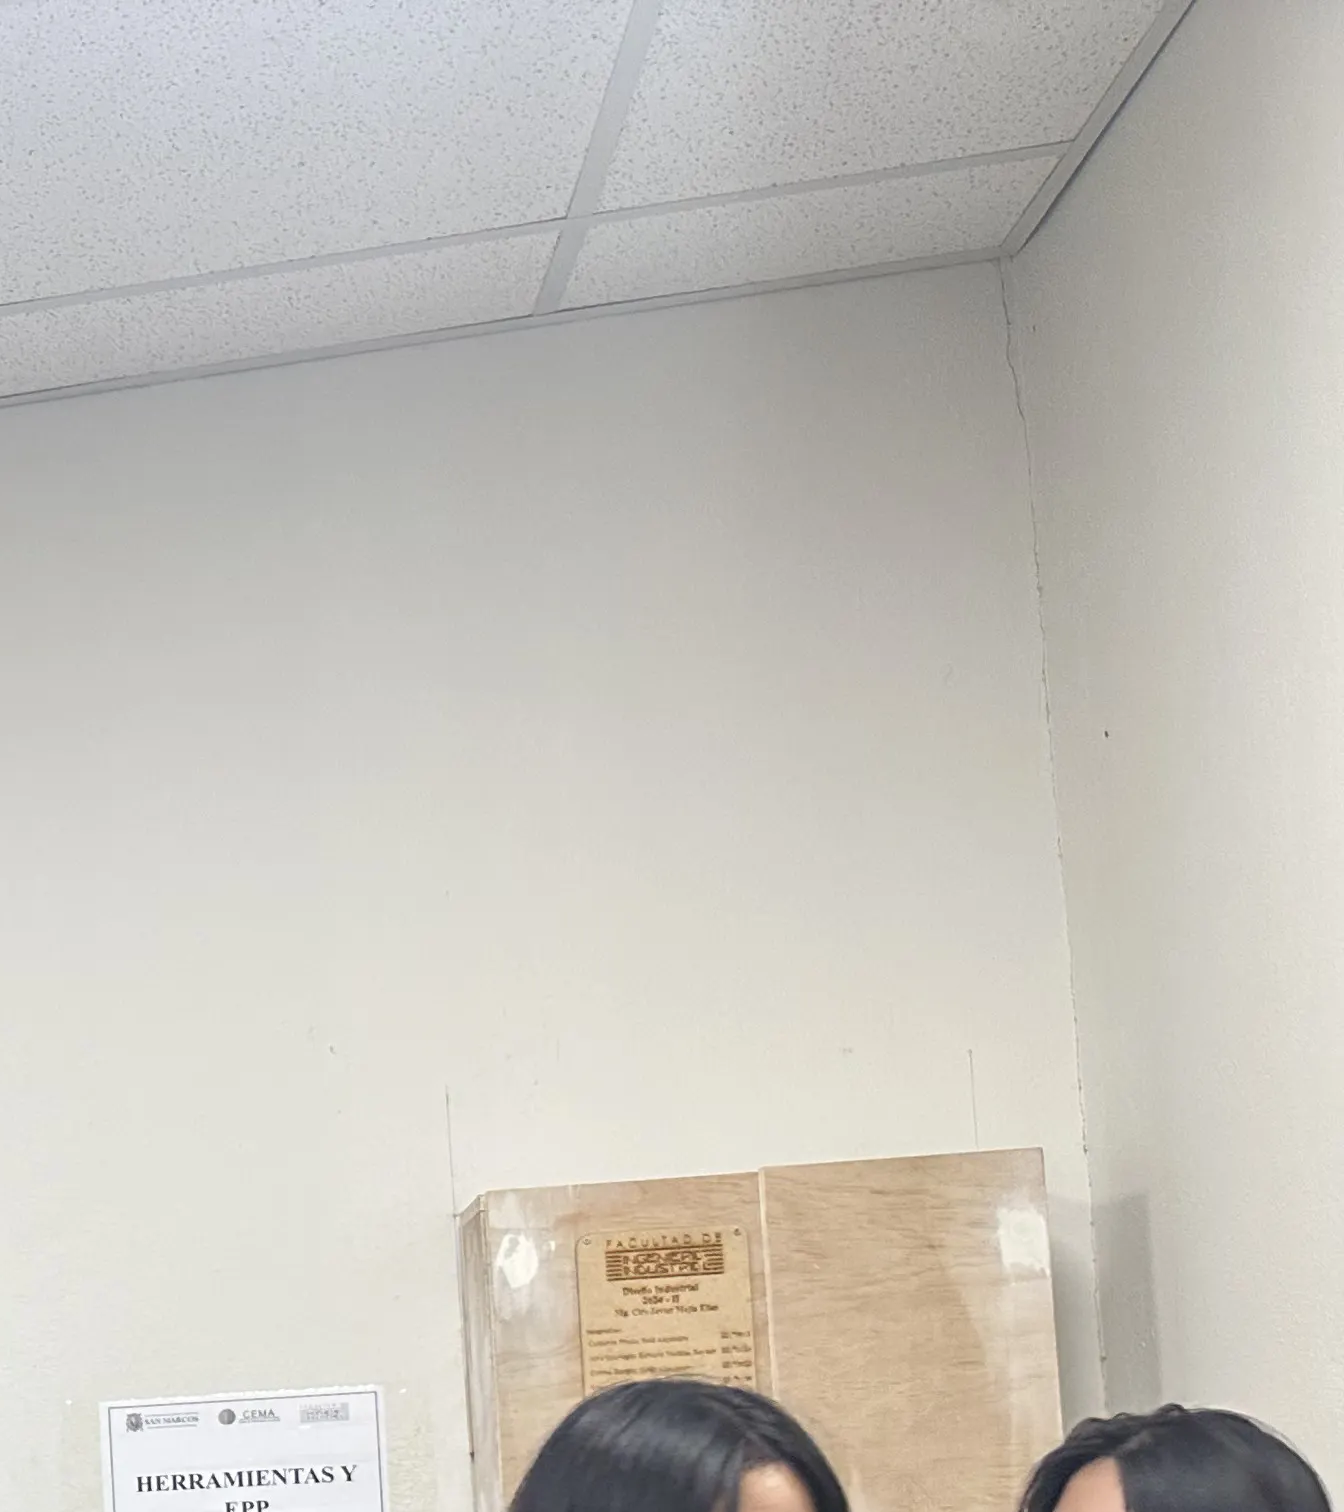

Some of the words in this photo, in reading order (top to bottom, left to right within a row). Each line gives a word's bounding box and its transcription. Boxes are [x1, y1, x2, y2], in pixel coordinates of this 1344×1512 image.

[606, 1233, 692, 1248] FACULTAD
[702, 1232, 722, 1244] DE
[242, 1409, 276, 1420] CEMA
[135, 1466, 335, 1493] HERRAMIENTAS
[340, 1464, 358, 1482] Y
